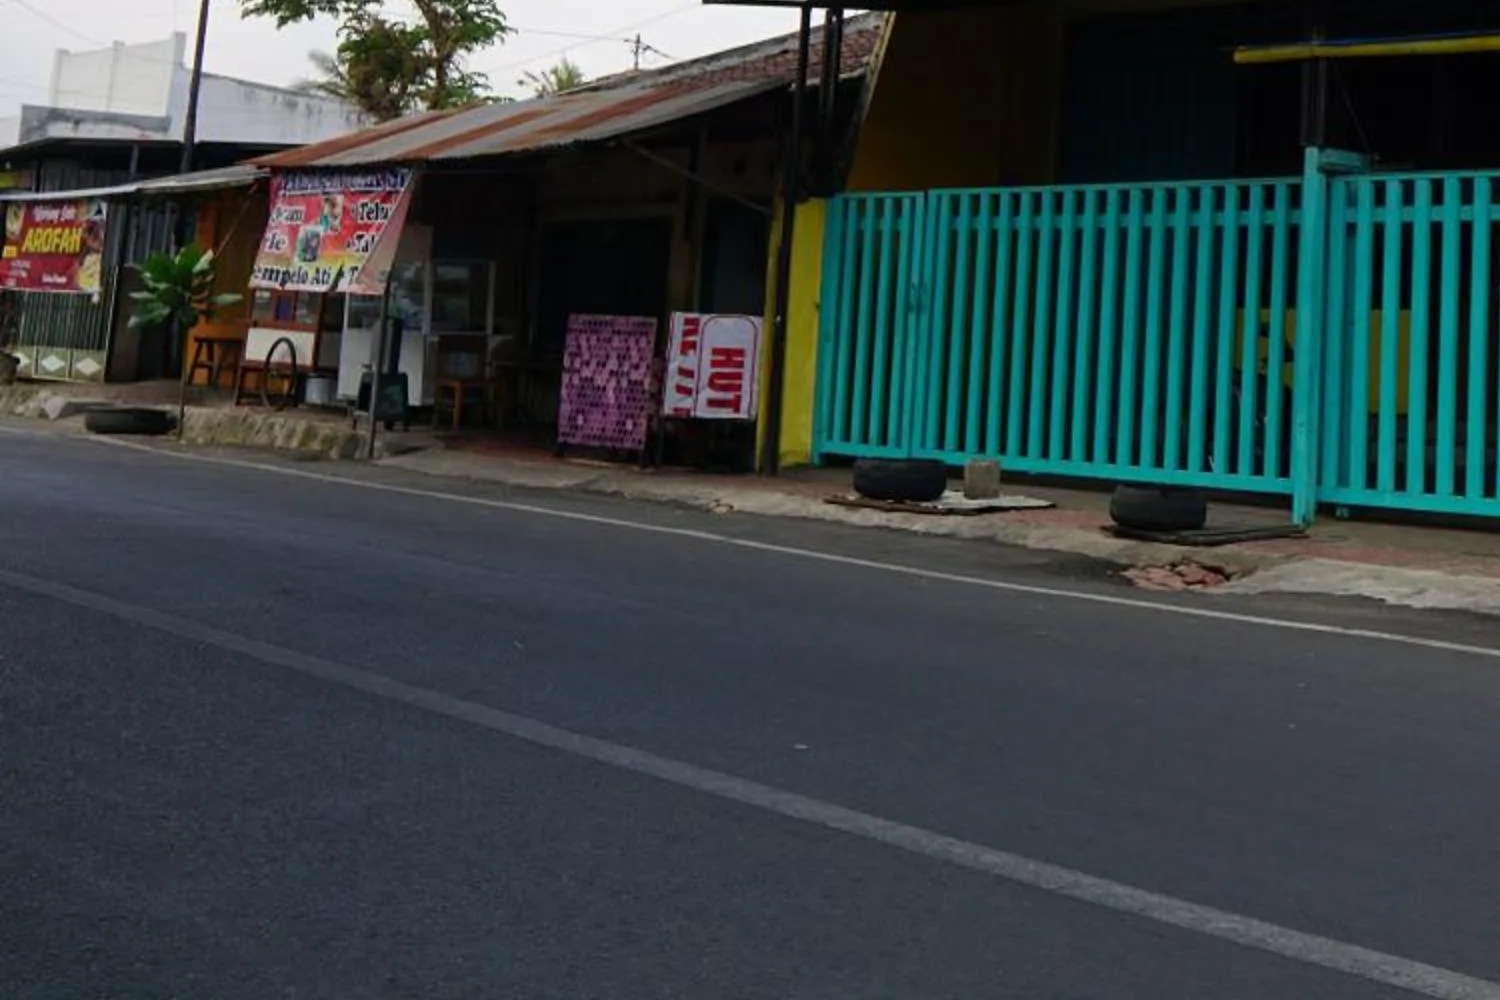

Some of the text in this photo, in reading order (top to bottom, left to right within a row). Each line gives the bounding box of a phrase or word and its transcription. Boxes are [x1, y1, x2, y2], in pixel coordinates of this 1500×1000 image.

[359, 201, 389, 221] Telu
[21, 225, 83, 254] AROFAH
[706, 347, 745, 414] HUT
